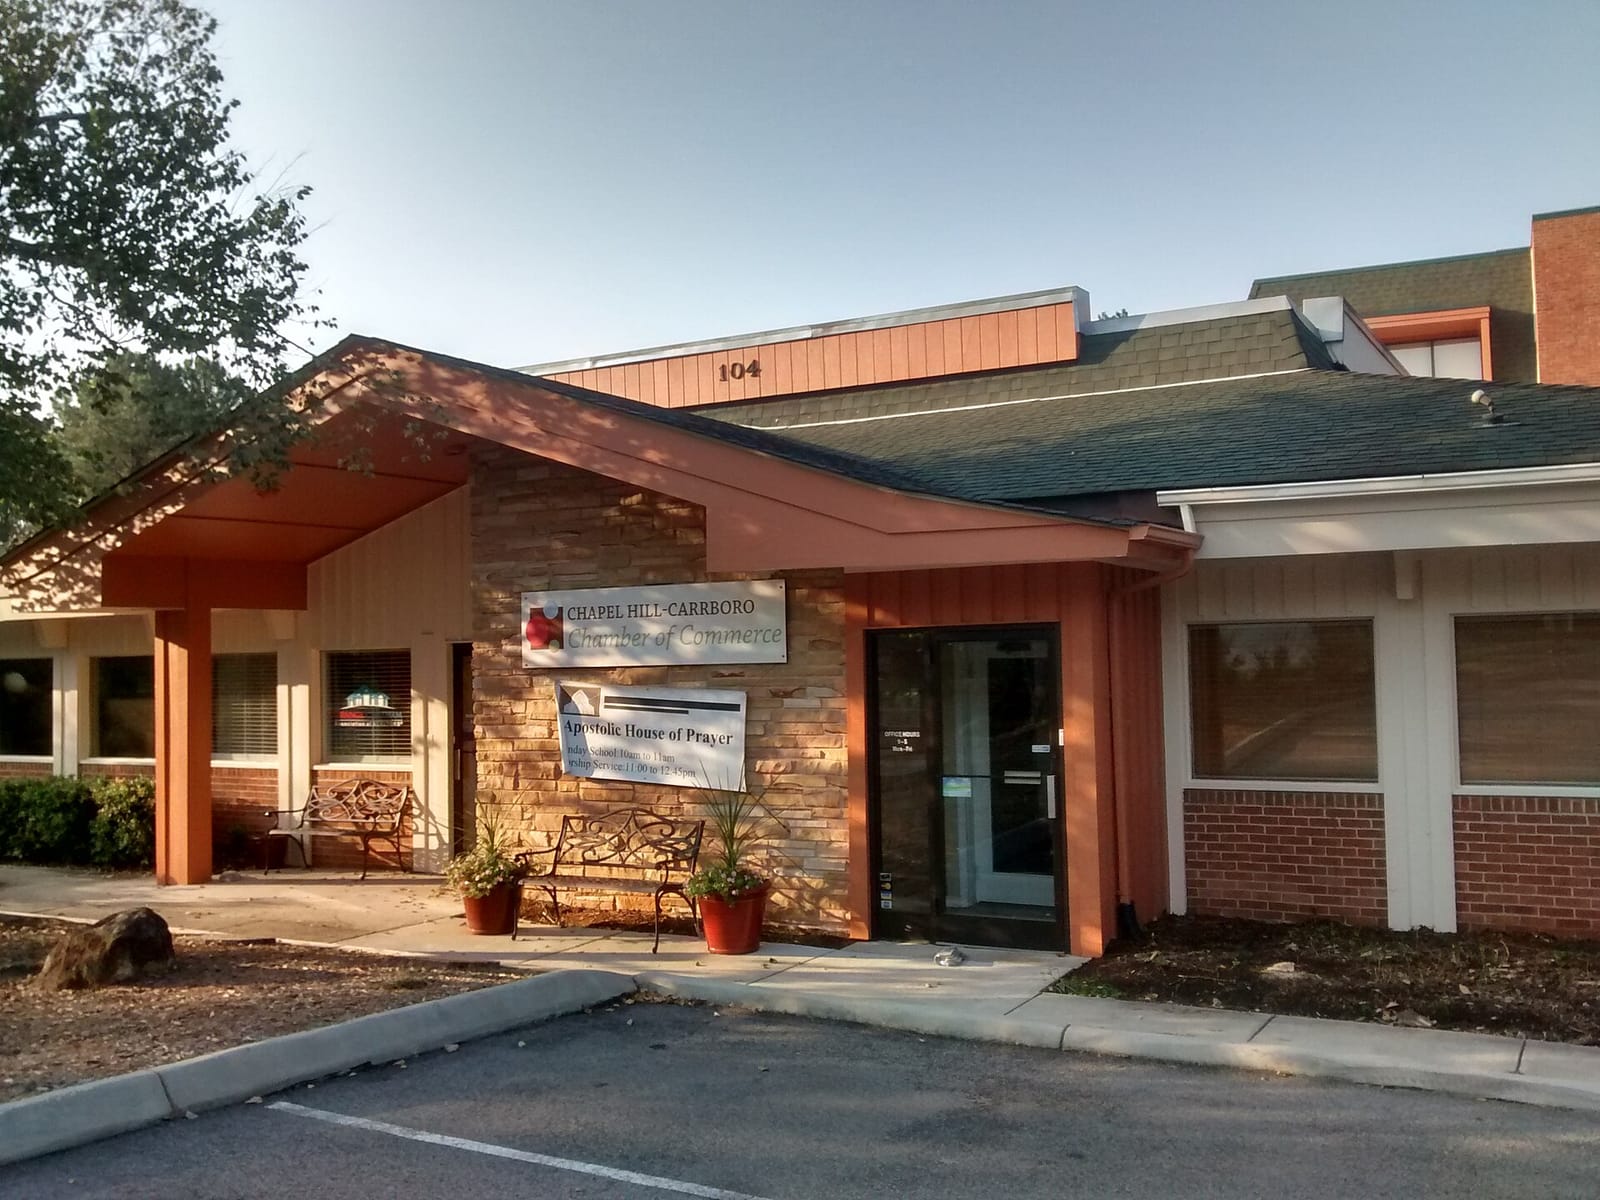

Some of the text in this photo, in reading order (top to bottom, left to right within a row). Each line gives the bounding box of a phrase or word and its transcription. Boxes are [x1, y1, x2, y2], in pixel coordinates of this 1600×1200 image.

[718, 359, 762, 382] 104
[567, 599, 755, 621] CHAPEL HILL-CARRBORO
[568, 624, 782, 650] Chamber of Commerce
[564, 719, 733, 748] Apostolic House of Prayer
[567, 744, 587, 757] nday
[643, 752, 651, 761] to
[653, 752, 675, 763] 11am
[568, 758, 591, 771] rship
[650, 764, 658, 774] to
